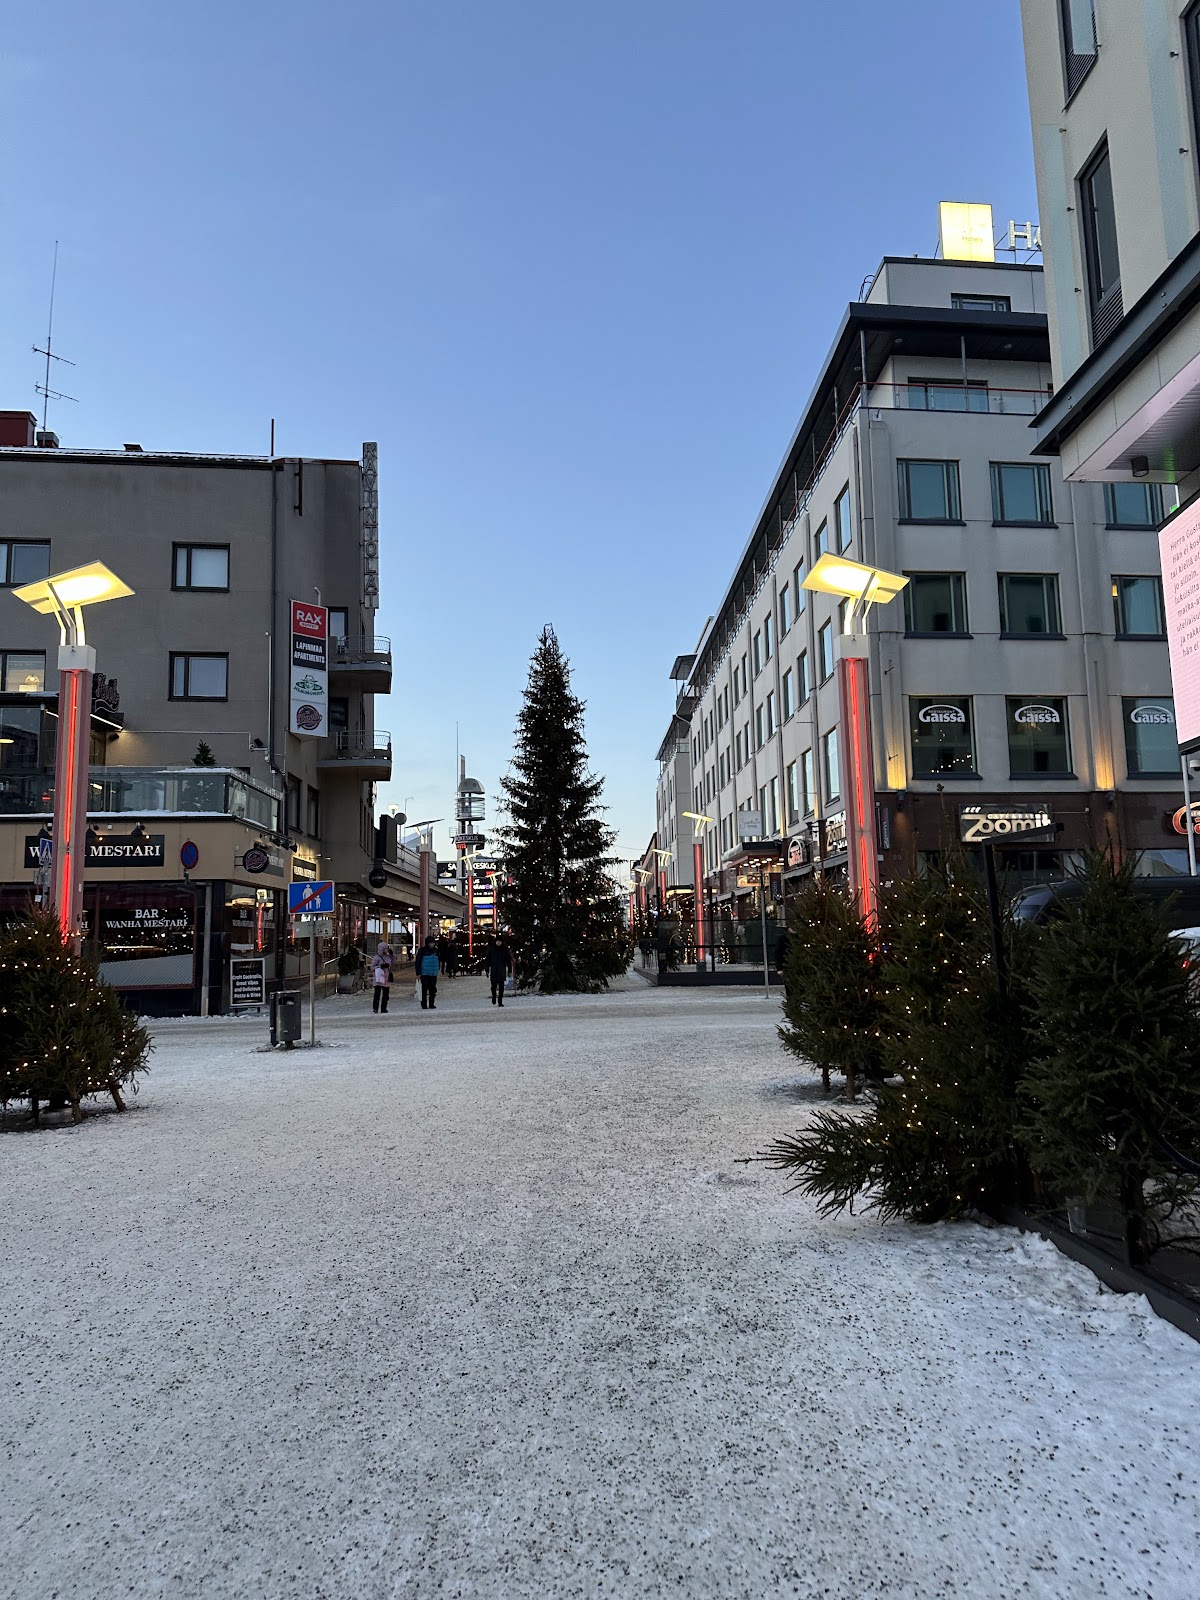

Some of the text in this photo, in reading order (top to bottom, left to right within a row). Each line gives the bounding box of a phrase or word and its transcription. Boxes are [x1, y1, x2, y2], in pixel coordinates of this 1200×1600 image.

[364, 442, 378, 608] RAVINTOLAT
[296, 609, 322, 625] RAX
[294, 651, 325, 664] APARTMENTS
[919, 704, 965, 723] Gaissa
[1014, 704, 1060, 723] Gaissa
[1130, 705, 1175, 724] Gaissa
[90, 845, 161, 857] MESTARI
[135, 908, 159, 919] BAR
[106, 918, 188, 929] WANHA MESTARI
